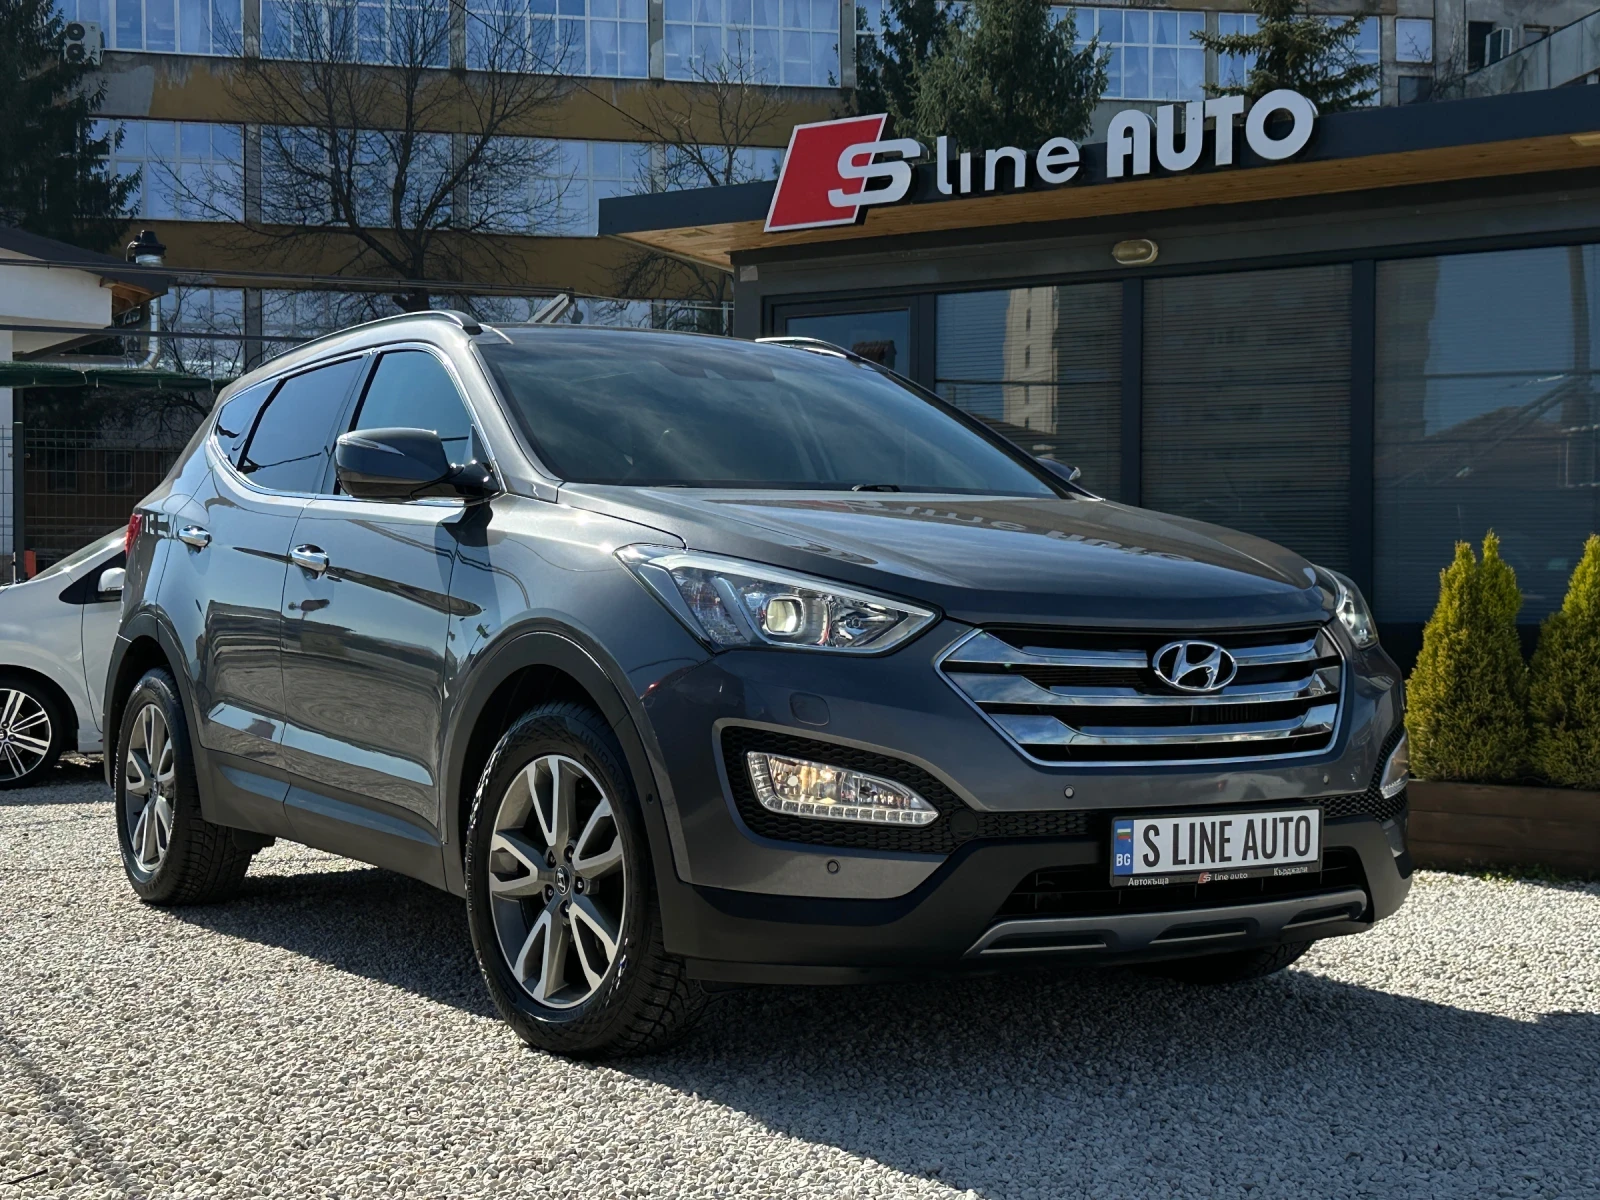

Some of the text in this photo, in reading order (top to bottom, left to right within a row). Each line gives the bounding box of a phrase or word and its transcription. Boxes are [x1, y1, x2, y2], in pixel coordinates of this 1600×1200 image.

[828, 138, 923, 208] S
[1106, 89, 1318, 178] AUTO
[1142, 815, 1311, 868] S LINE AUTO
[1115, 853, 1131, 867] BG
[1127, 877, 1170, 887] Автокъща
[1230, 871, 1249, 880] auto
